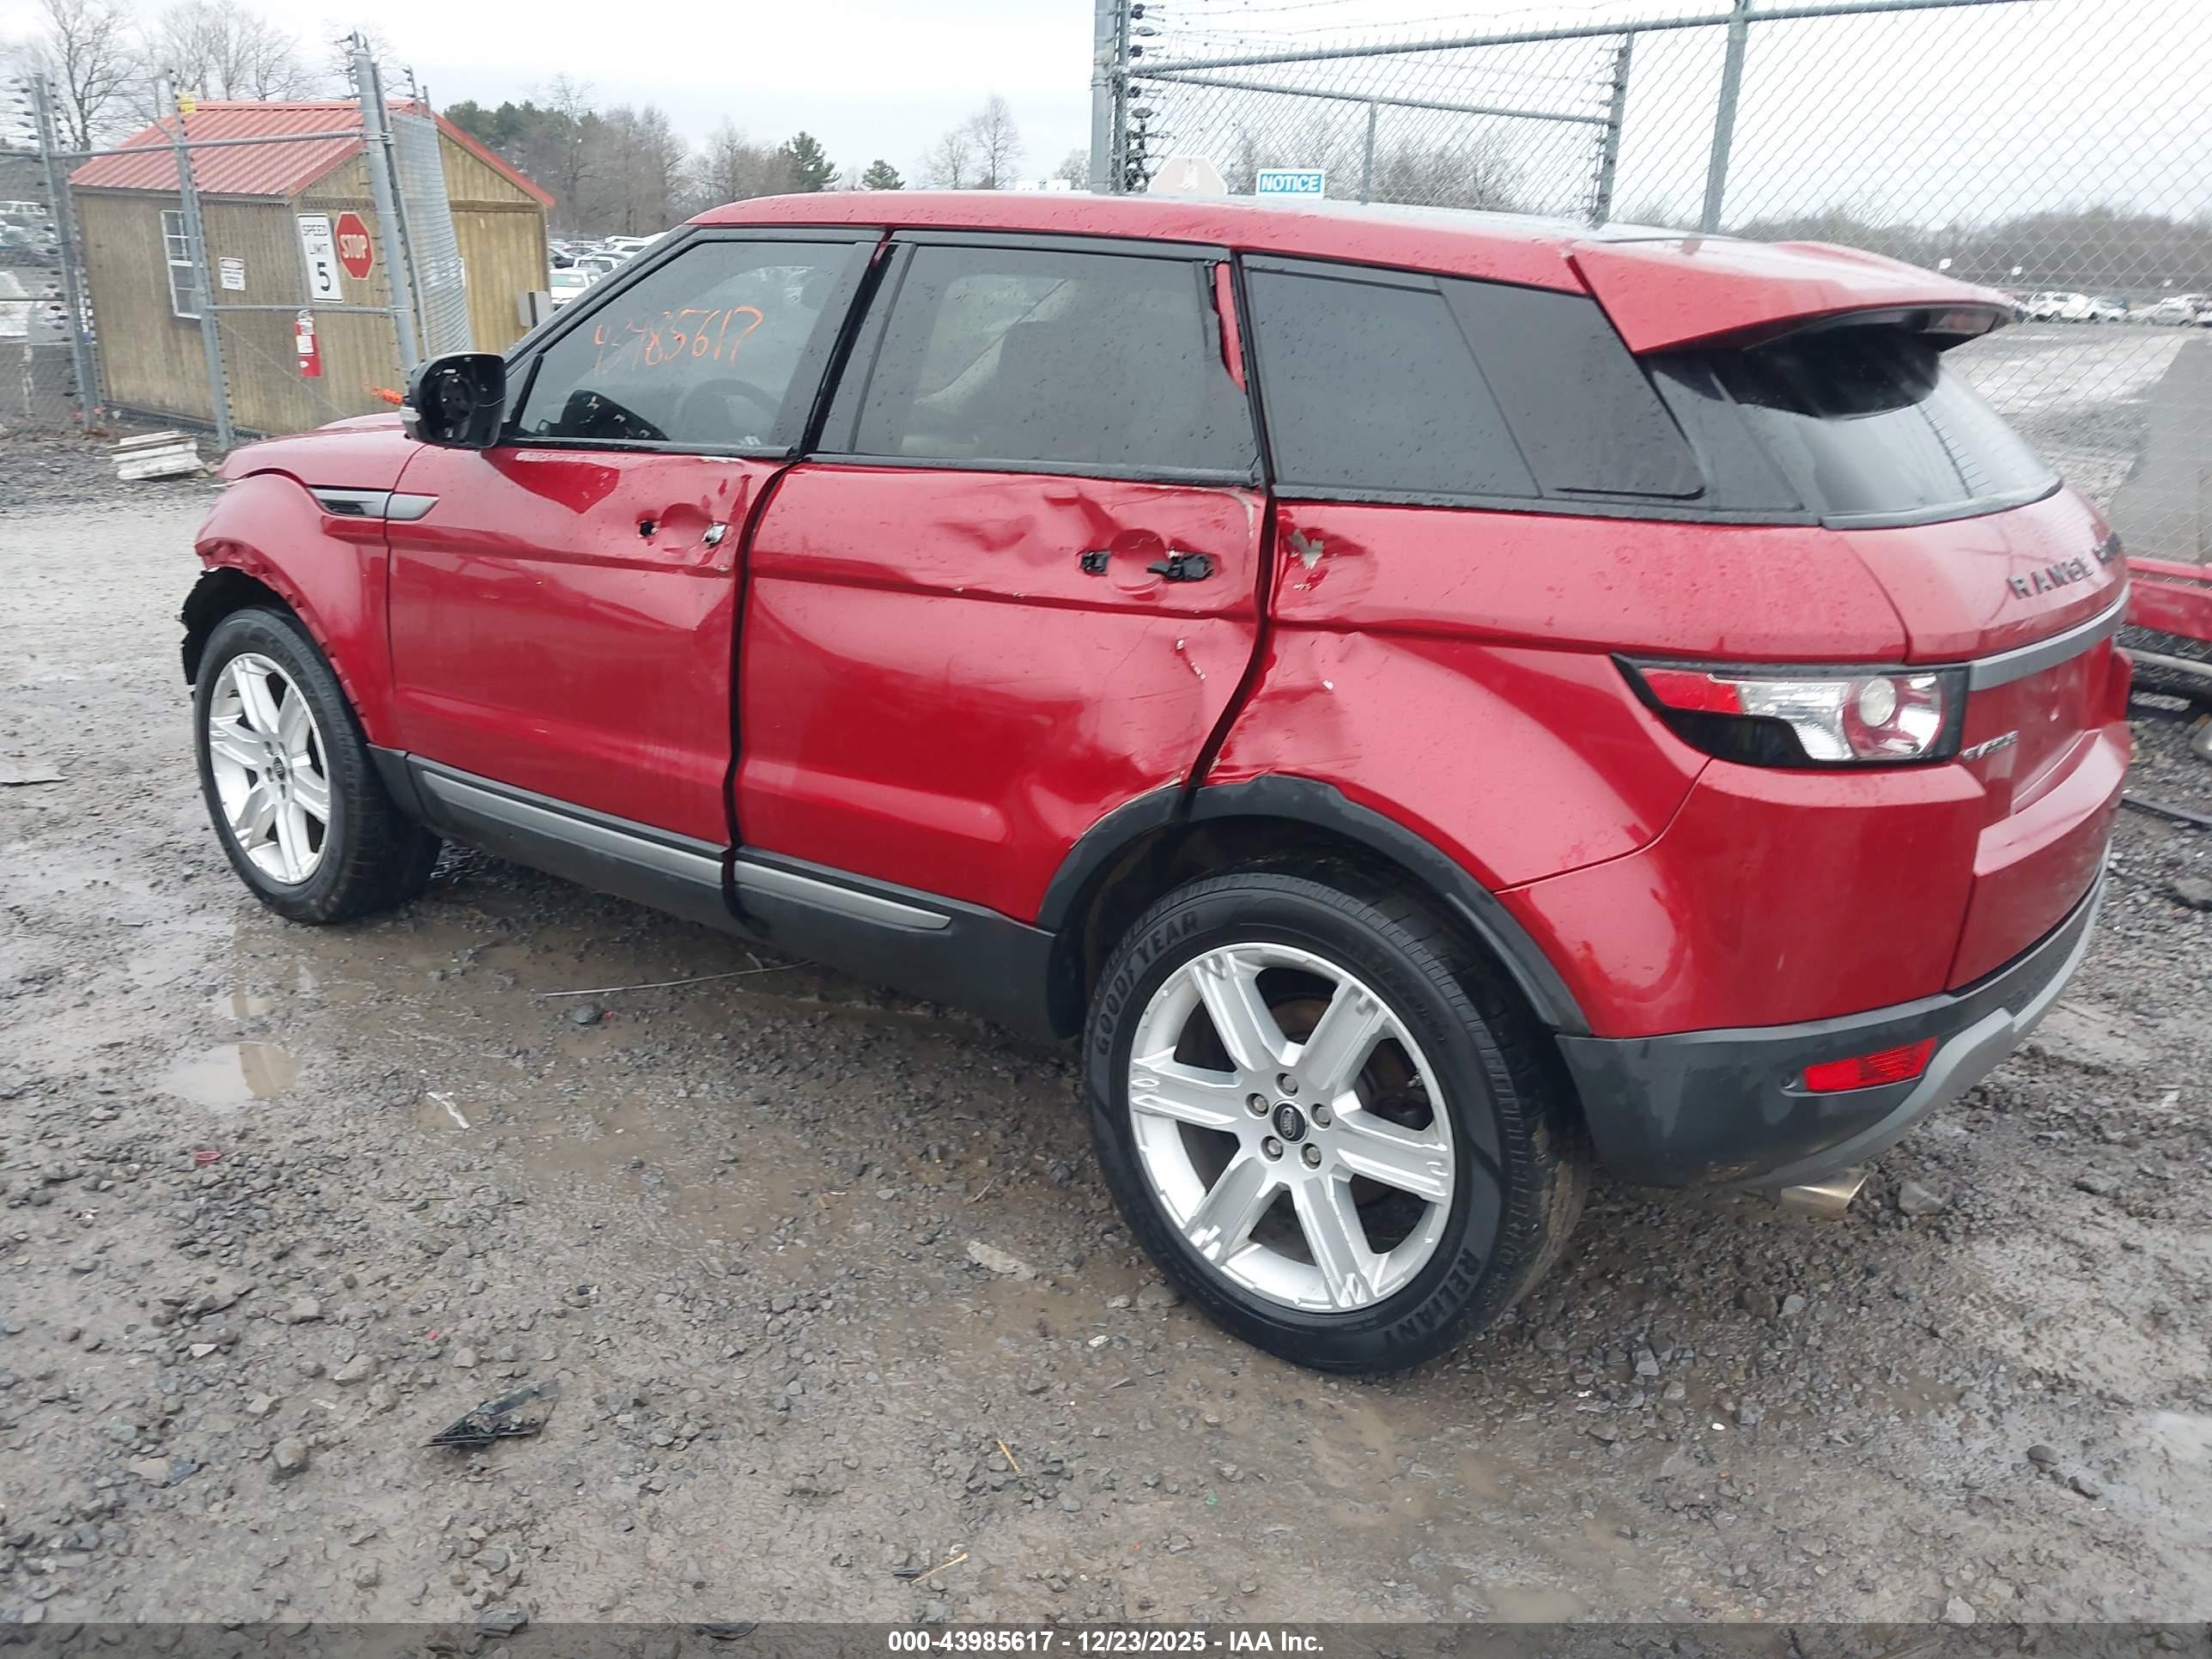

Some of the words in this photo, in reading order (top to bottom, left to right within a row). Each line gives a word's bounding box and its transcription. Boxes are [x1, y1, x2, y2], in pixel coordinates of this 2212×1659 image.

[1261, 175, 1320, 191] NOTICE
[301, 224, 328, 237] SPEED
[338, 234, 368, 259] STOP
[317, 262, 331, 291] 5
[2006, 557, 2094, 599] RANGE
